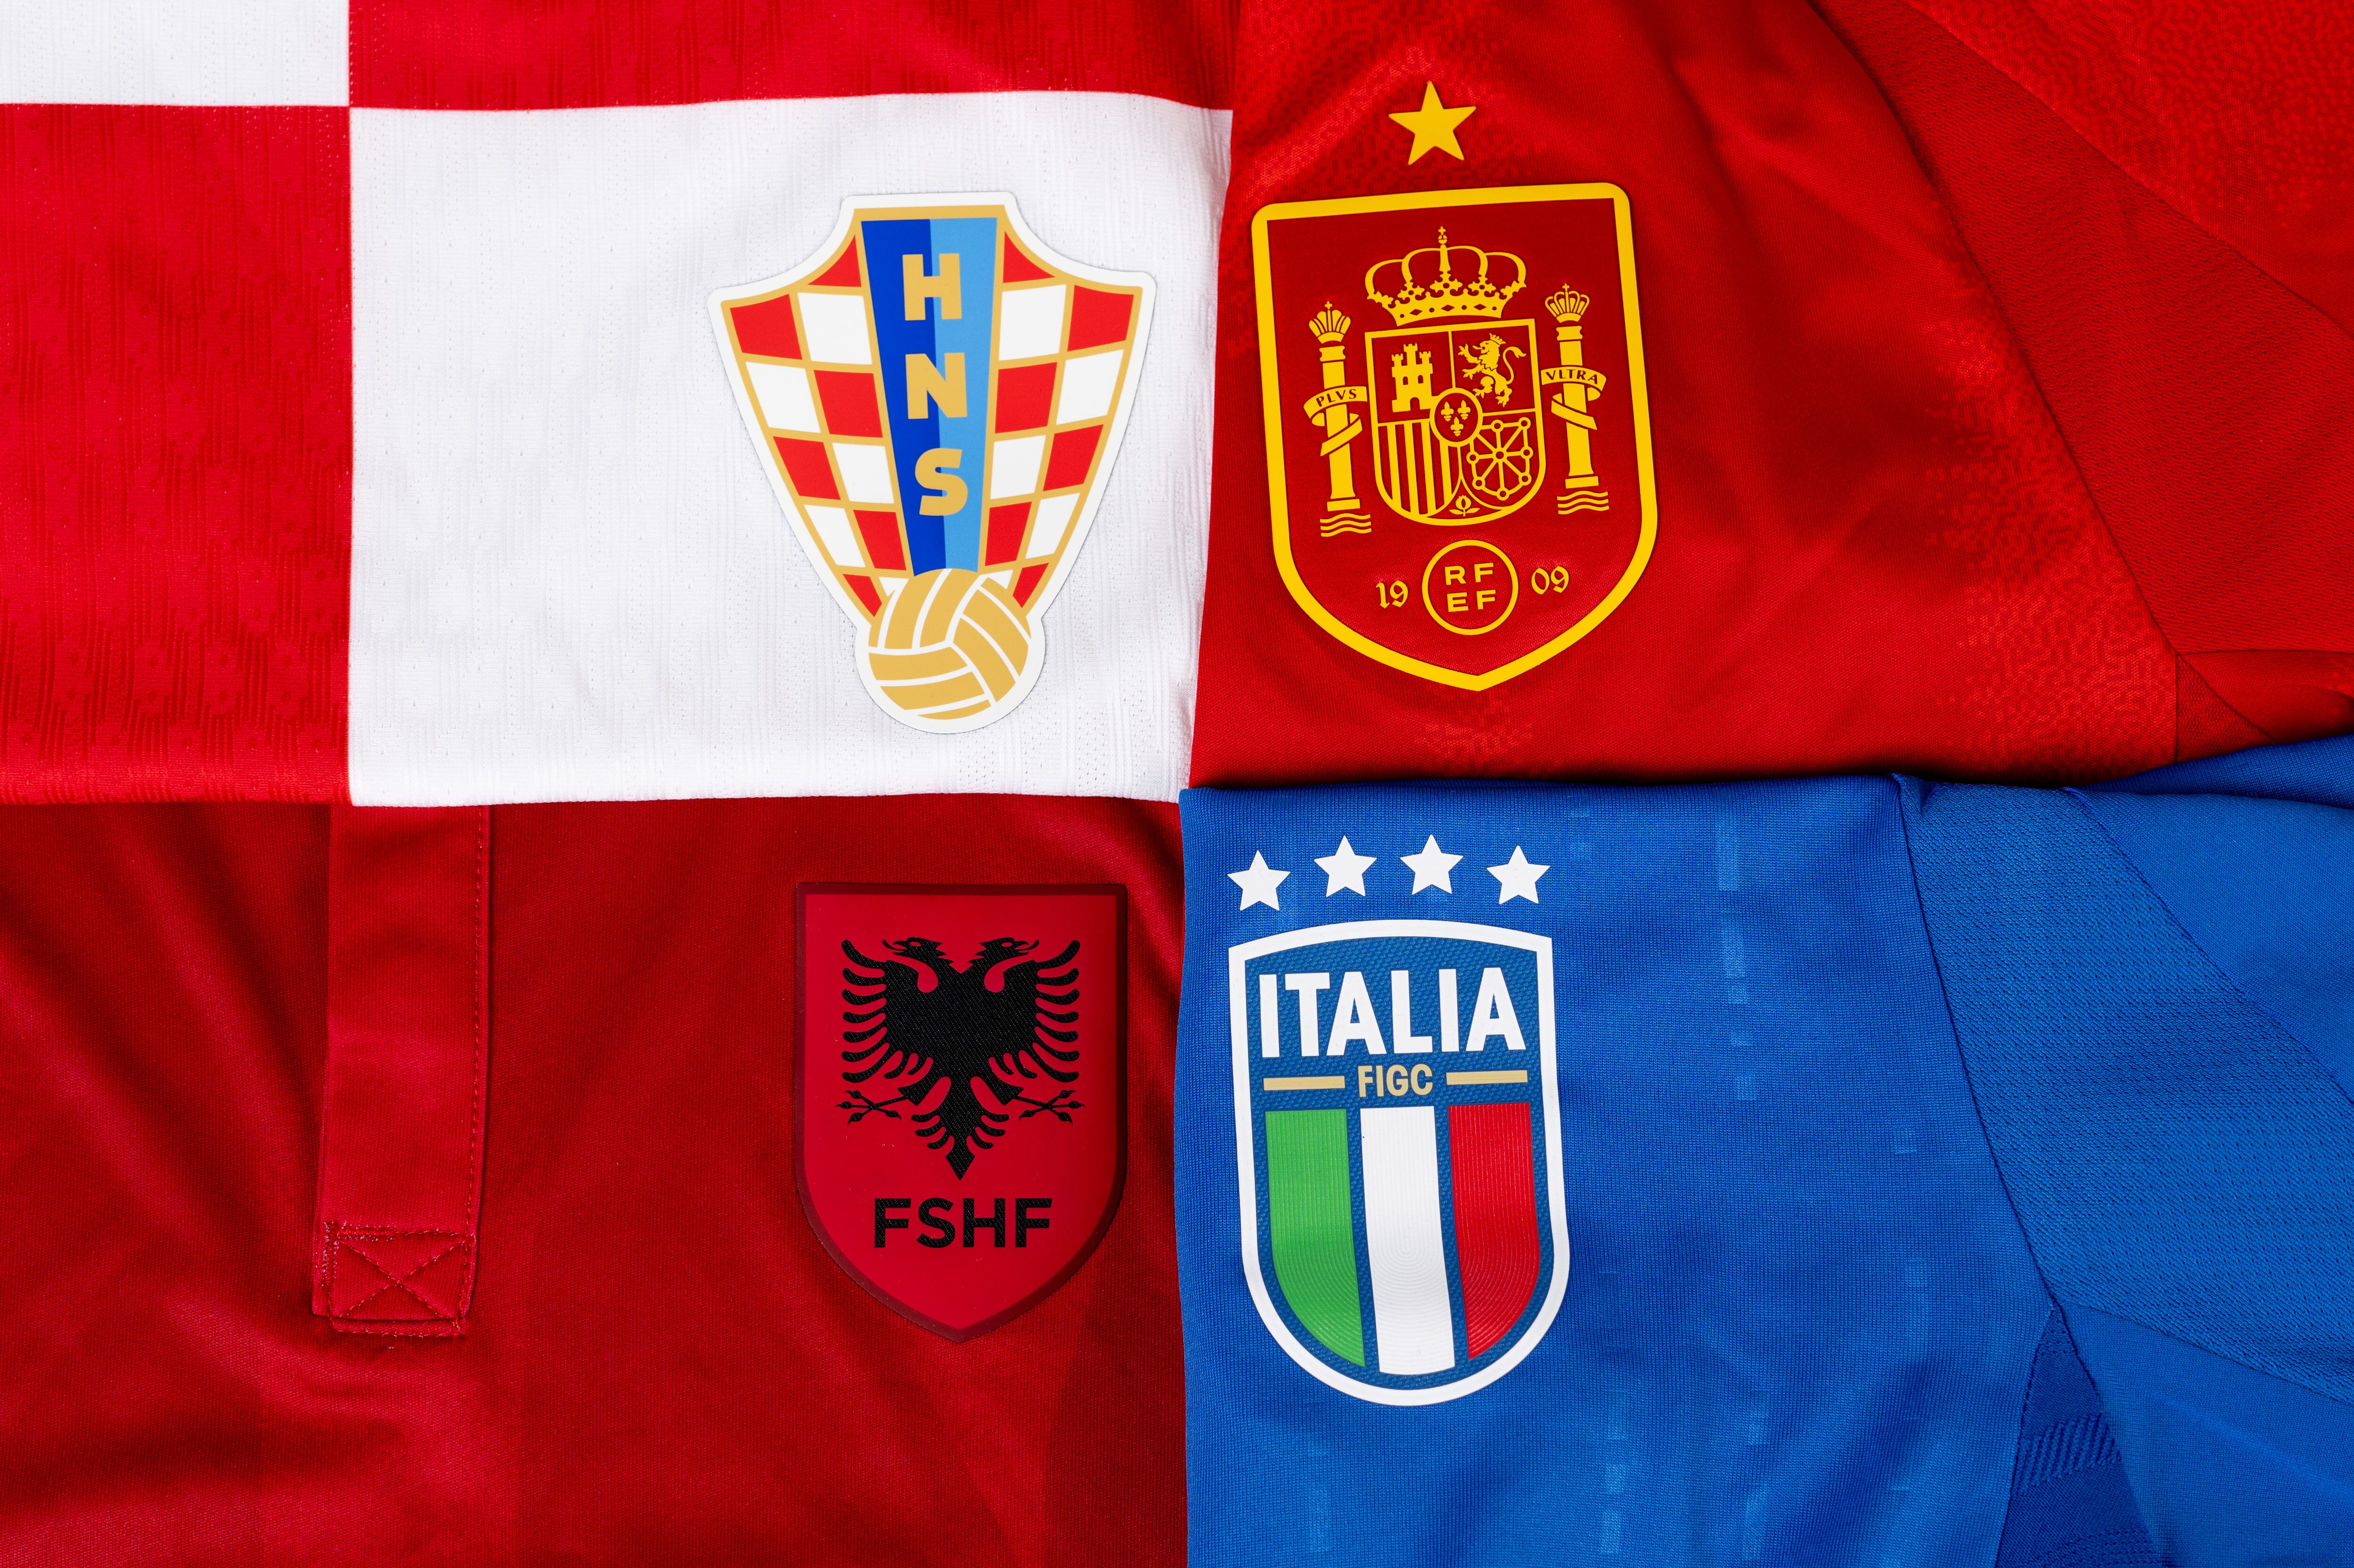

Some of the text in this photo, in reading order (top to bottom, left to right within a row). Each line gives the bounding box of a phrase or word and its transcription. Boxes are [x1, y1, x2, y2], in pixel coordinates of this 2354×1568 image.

[903, 253, 968, 516] HNS
[1546, 369, 1597, 384] VLTRA
[1316, 389, 1357, 407] PLVS
[1376, 580, 1409, 609] 19
[1531, 565, 1569, 595] 09
[1259, 967, 1526, 1058] ITALIA
[1358, 1064, 1433, 1097] FIGC
[874, 1198, 1052, 1248] FSHF
